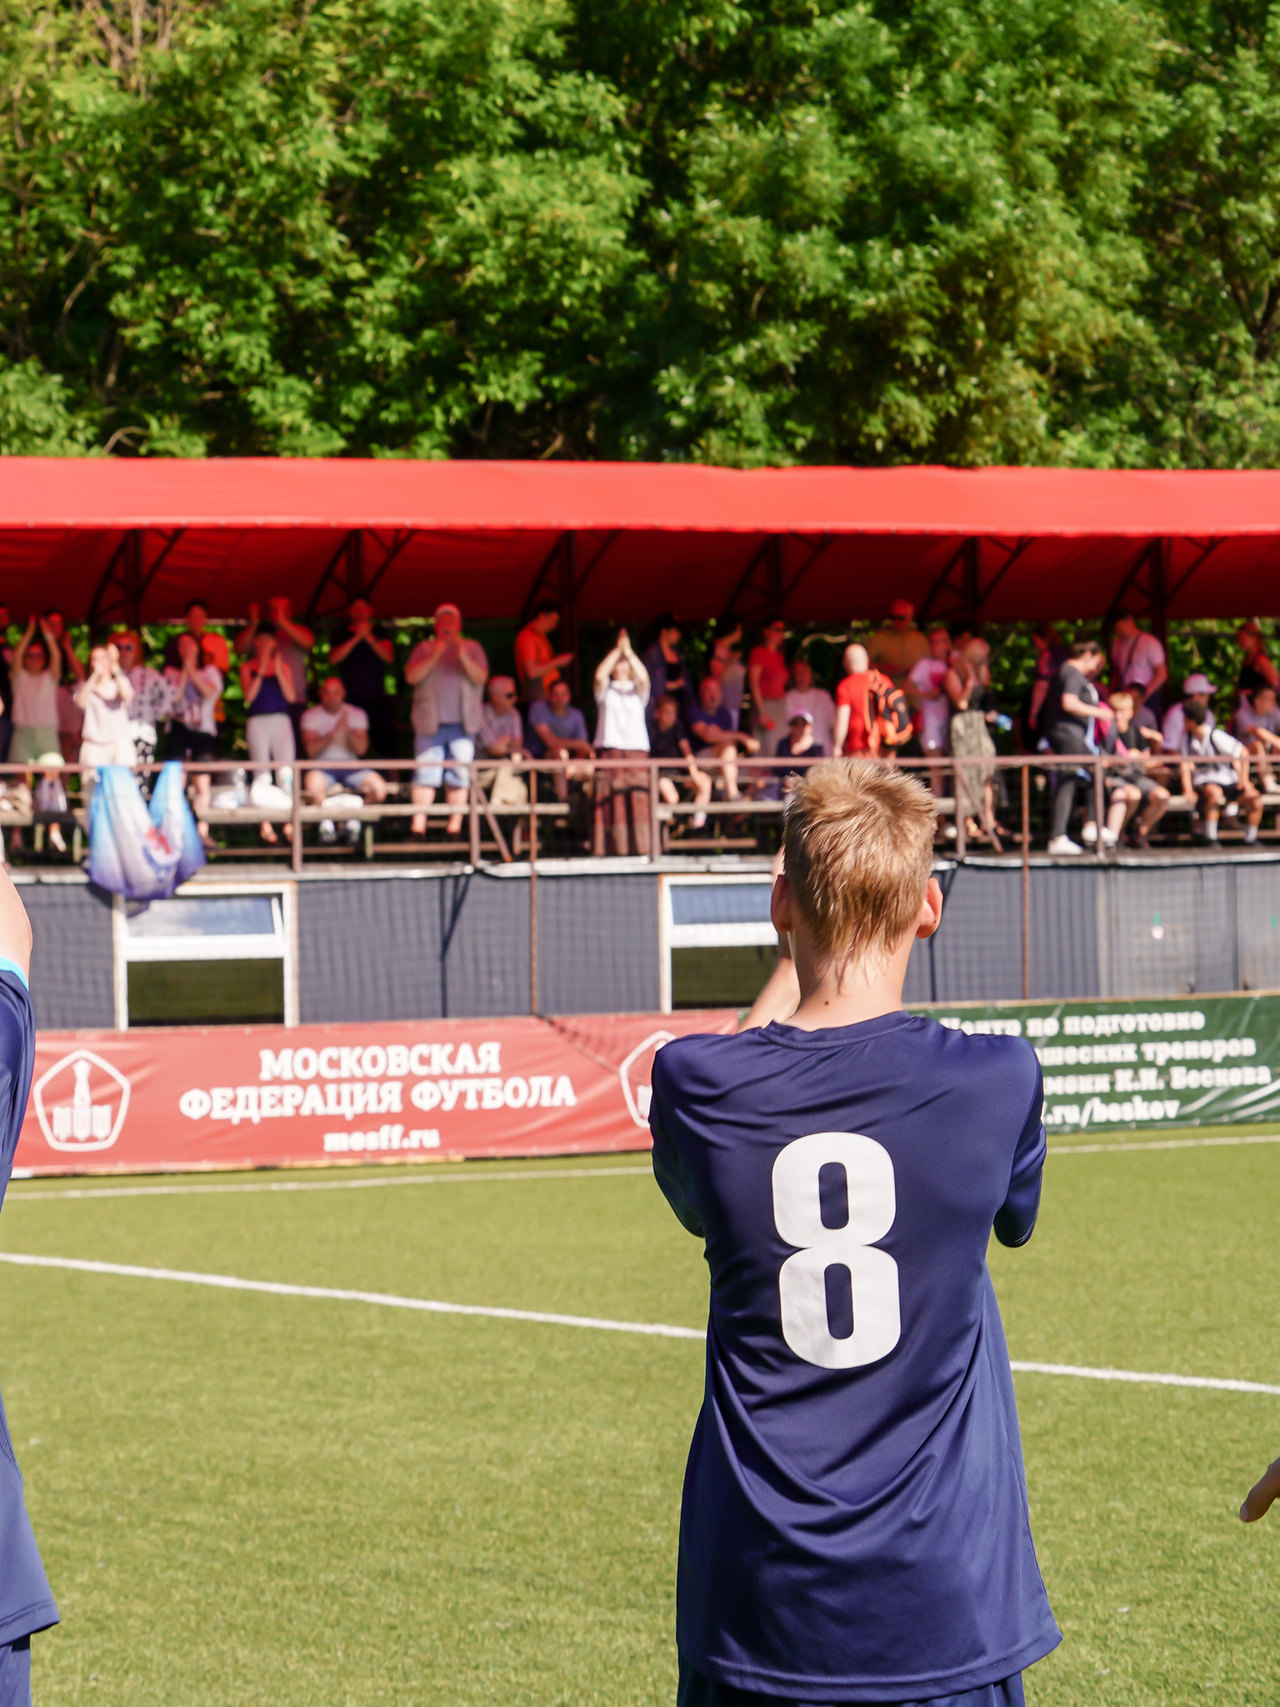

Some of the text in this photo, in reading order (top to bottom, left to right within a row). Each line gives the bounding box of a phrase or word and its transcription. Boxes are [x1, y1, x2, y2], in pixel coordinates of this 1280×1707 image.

[1026, 1017, 1060, 1037] по
[1063, 1011, 1206, 1038] подготовке
[258, 1041, 502, 1081] МОСКОВСКАЯ
[1034, 1038, 1257, 1066] шеских тренеров
[1043, 1073, 1111, 1095] мени
[1169, 1066, 1272, 1090] Бескова
[178, 1074, 578, 1124] ФЕДЕРАЦИЯ ФУТБОЛА
[1041, 1095, 1180, 1128] .ru/beskov
[323, 1123, 441, 1152] mosff.ru
[772, 1131, 901, 1370] 8
